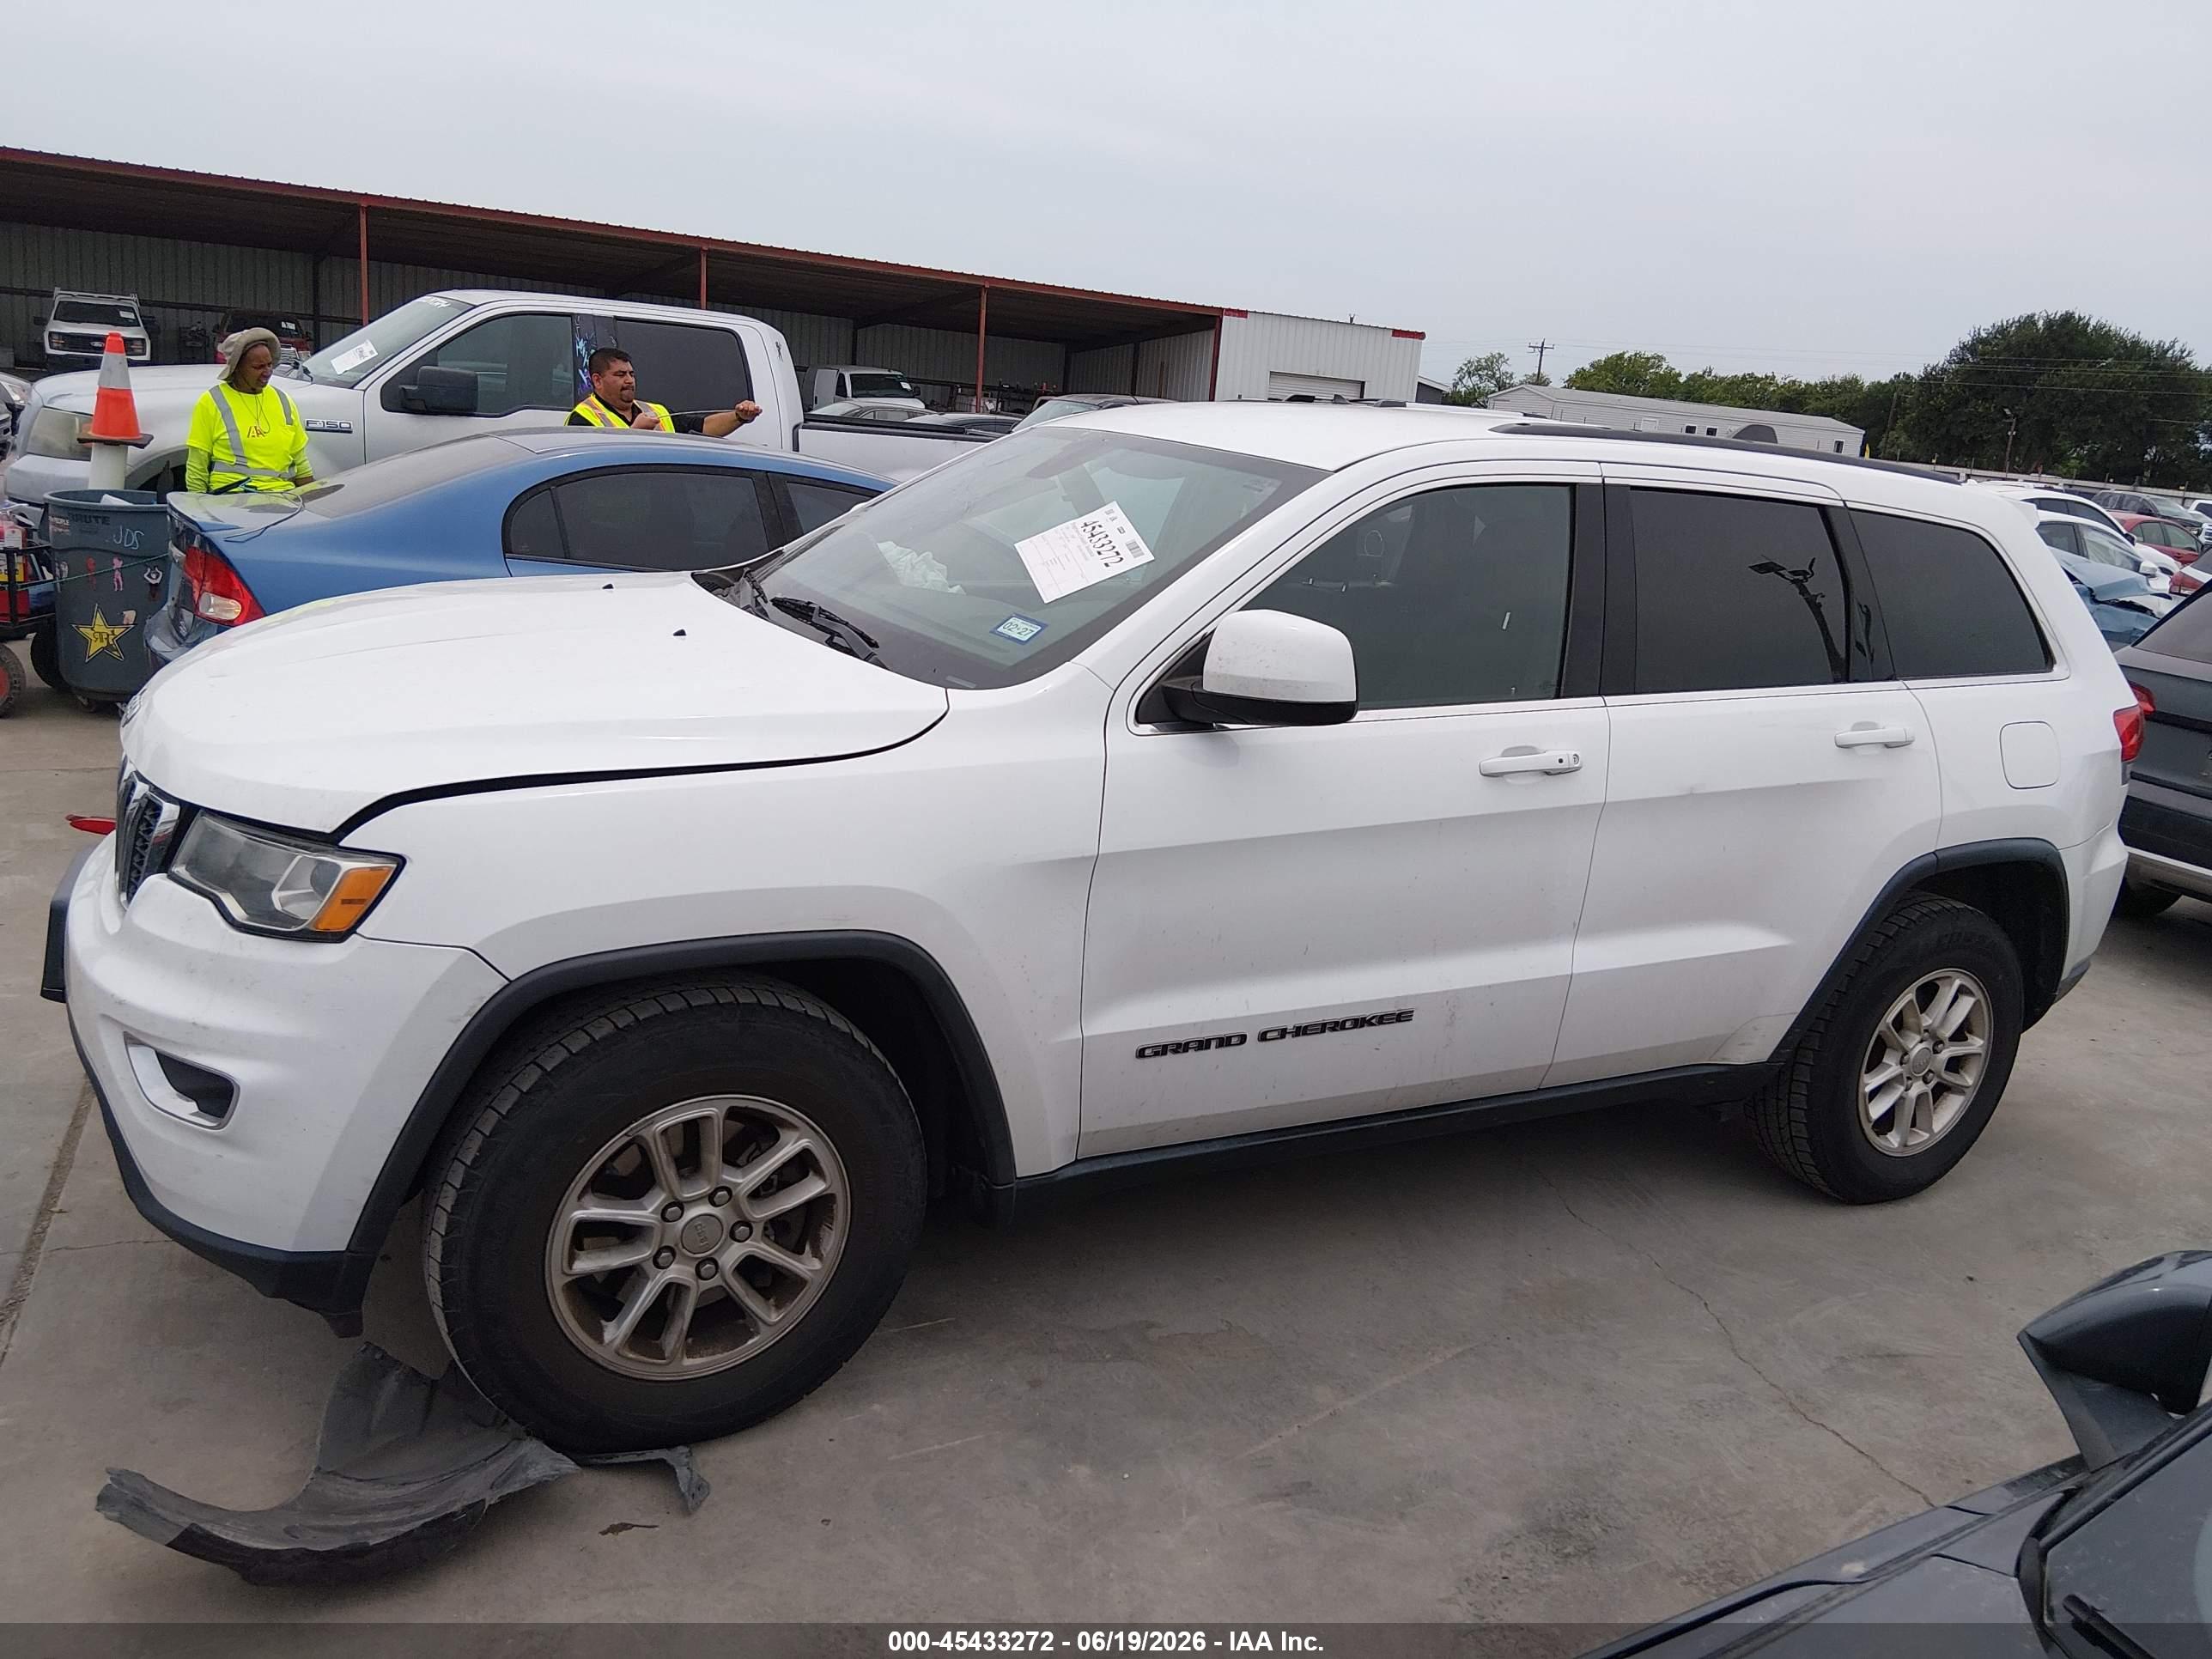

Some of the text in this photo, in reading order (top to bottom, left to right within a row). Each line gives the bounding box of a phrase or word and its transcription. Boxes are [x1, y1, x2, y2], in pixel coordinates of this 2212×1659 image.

[1081, 520, 1124, 568] 45433272
[1135, 1007, 1416, 1060] GRAND CHEROKEE
